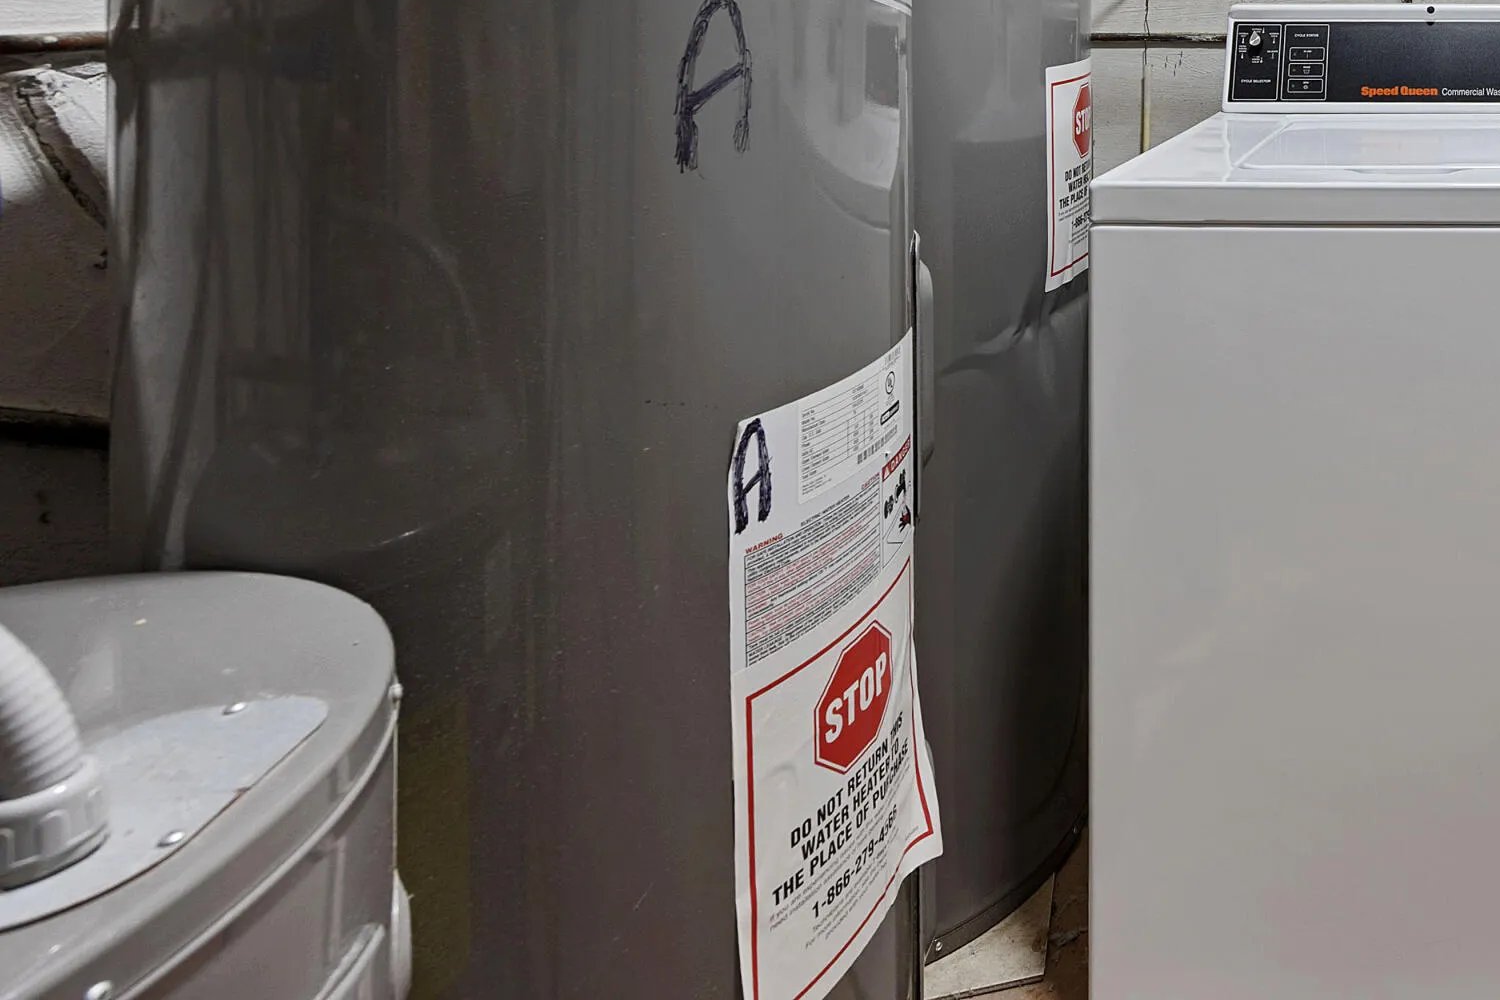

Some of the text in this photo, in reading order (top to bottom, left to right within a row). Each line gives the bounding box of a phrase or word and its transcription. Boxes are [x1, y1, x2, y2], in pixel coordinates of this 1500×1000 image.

[1361, 86, 1399, 98] Speed
[1400, 86, 1438, 96] Queen
[1441, 87, 1485, 96] Commercial
[1076, 106, 1091, 135] STO
[1059, 195, 1069, 209] THE
[1071, 189, 1083, 205] PLACE
[734, 418, 772, 535] A
[745, 532, 784, 554] WARNING
[825, 651, 887, 743] STOP
[790, 818, 812, 849] DO
[817, 788, 843, 826] NOT
[847, 738, 888, 797] RETURN
[772, 868, 804, 906] THE
[810, 822, 852, 877] PLACE
[856, 802, 869, 829] OF
[801, 804, 849, 860] WATER
